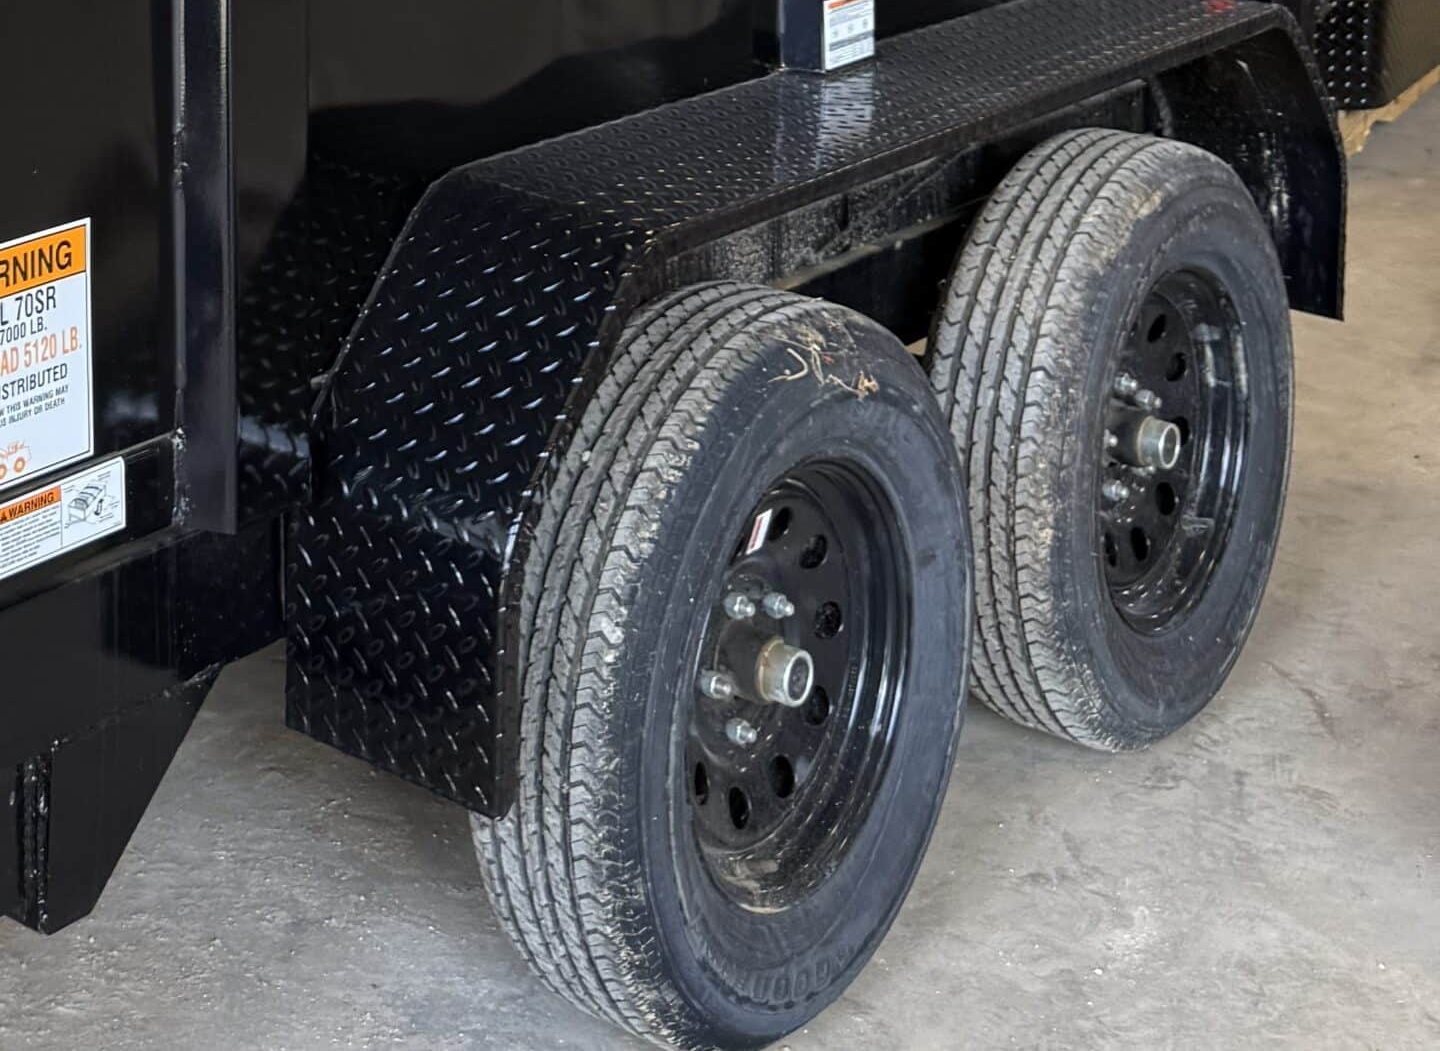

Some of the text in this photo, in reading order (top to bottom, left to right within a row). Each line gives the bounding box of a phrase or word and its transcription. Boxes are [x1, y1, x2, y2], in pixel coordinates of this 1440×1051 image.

[15, 285, 57, 321] 70SR
[0, 322, 27, 346] 7000
[30, 316, 48, 335] LB.
[24, 333, 57, 368] 5120
[62, 325, 82, 355] LB.
[7, 401, 21, 414] THIS
[23, 390, 54, 409] WARNING
[55, 384, 69, 398] MAY
[9, 409, 32, 426] INJURY
[34, 405, 43, 416] OR
[45, 398, 66, 413] DEATH
[8, 491, 54, 518] WARNING
